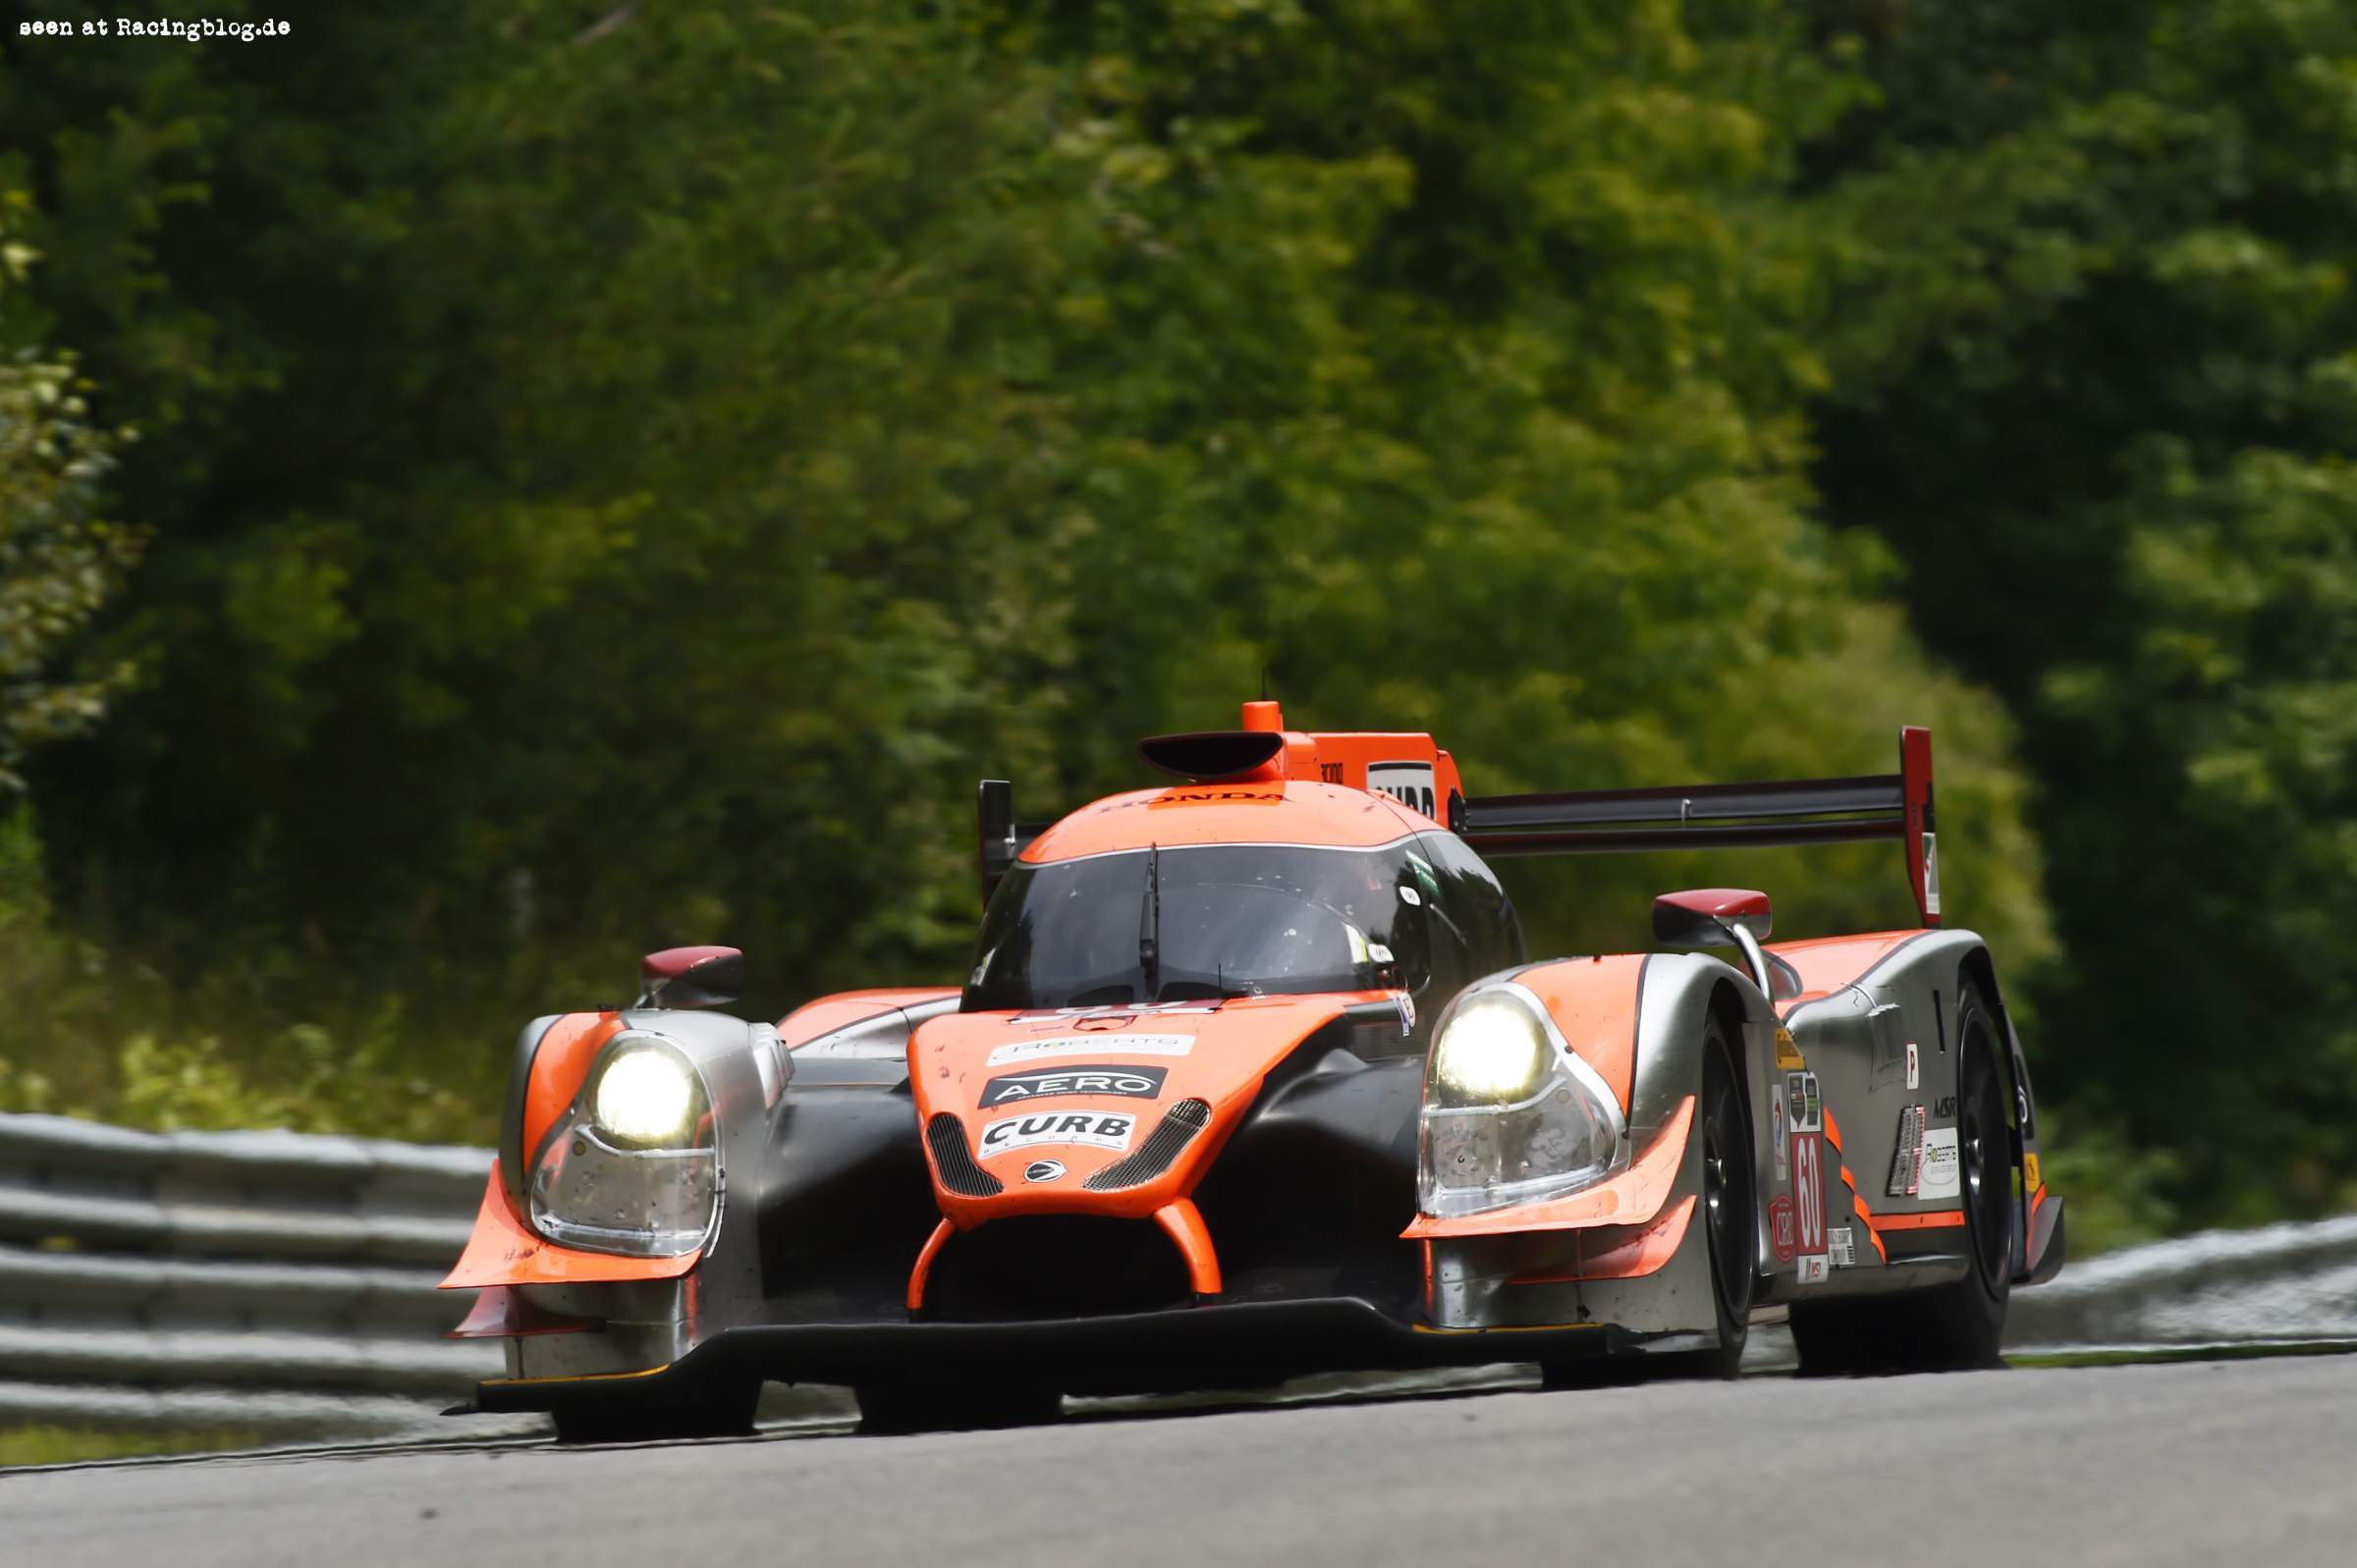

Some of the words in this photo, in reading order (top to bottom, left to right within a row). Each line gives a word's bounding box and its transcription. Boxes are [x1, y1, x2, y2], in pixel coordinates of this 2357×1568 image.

[993, 1076, 1152, 1101] AERO
[984, 1115, 1131, 1144] CURB
[1798, 1137, 1821, 1249] 60
